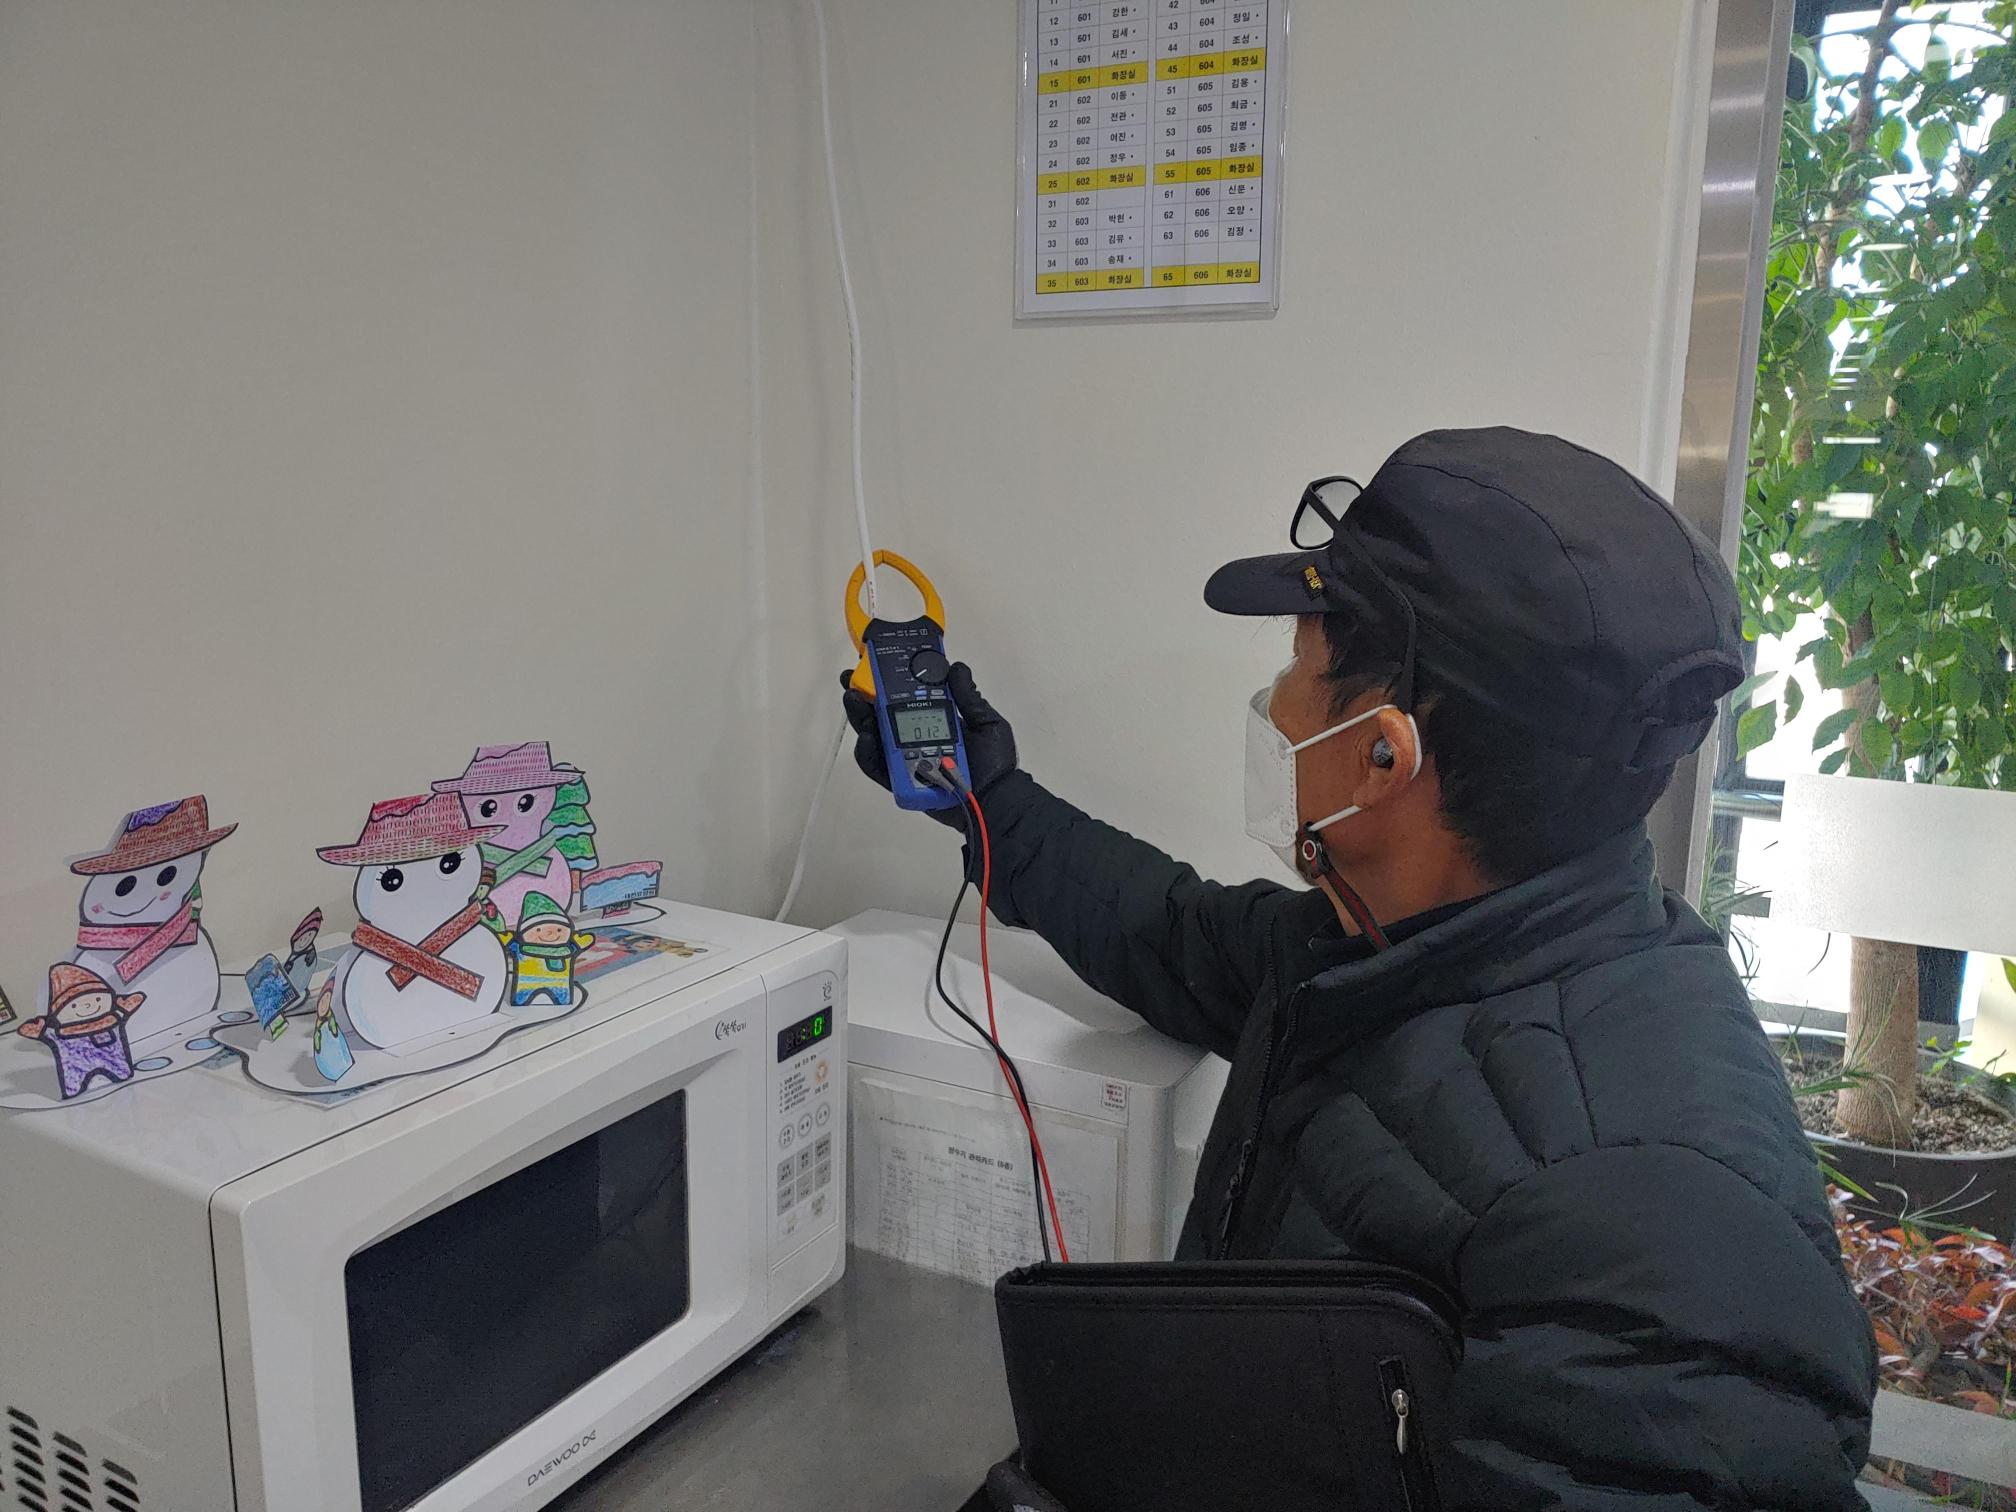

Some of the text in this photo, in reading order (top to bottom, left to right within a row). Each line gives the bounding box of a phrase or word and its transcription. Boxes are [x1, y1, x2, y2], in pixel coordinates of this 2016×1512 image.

[1050, 17, 1059, 25] 12
[1078, 13, 1091, 22] 601
[1168, 22, 1178, 30] 43
[1200, 18, 1214, 26] 604
[1050, 38, 1058, 46] 13
[1078, 34, 1091, 42] 601
[1168, 34, 1250, 52] 44 604 조성
[1078, 55, 1090, 63] 601
[1112, 49, 1128, 59] 서진
[1168, 55, 1258, 73] 45 604 화장실
[1050, 69, 1136, 88] 15 601 화장실
[1167, 86, 1176, 94] 51
[1198, 82, 1213, 91] 605
[1049, 100, 1058, 108] 21
[1077, 96, 1091, 104] 602
[1166, 106, 1176, 115] 52
[1198, 104, 1212, 112] 605
[1049, 120, 1058, 128] 22
[1077, 116, 1090, 124] 602
[1166, 128, 1176, 136] 53
[1197, 124, 1212, 133] 605
[1049, 140, 1058, 148] 23
[1076, 136, 1090, 145] 602
[1166, 149, 1175, 157] 54
[1196, 146, 1212, 154] 605
[1048, 160, 1057, 168] 24
[1076, 157, 1090, 166] 602
[1165, 162, 1254, 178] 55 605 화장실
[1048, 172, 1134, 188] 25 602 화장실
[1164, 190, 1174, 198] 61
[1196, 188, 1210, 196] 606
[1048, 197, 1090, 208] 31 602
[1164, 211, 1174, 219] 62
[1195, 208, 1210, 216] 606
[1048, 220, 1056, 228] 32
[1076, 217, 1089, 226] 603
[1164, 232, 1173, 240] 63
[1194, 230, 1209, 238] 606
[1048, 240, 1056, 248] 33
[1075, 238, 1088, 246] 603
[1048, 260, 1056, 268] 34
[1075, 258, 1088, 266] 603
[1194, 271, 1208, 279] 606
[1227, 268, 1252, 278] 화장실
[1048, 274, 1132, 288] 35 603 화장실
[528, 1443, 580, 1486] DAEWOO
